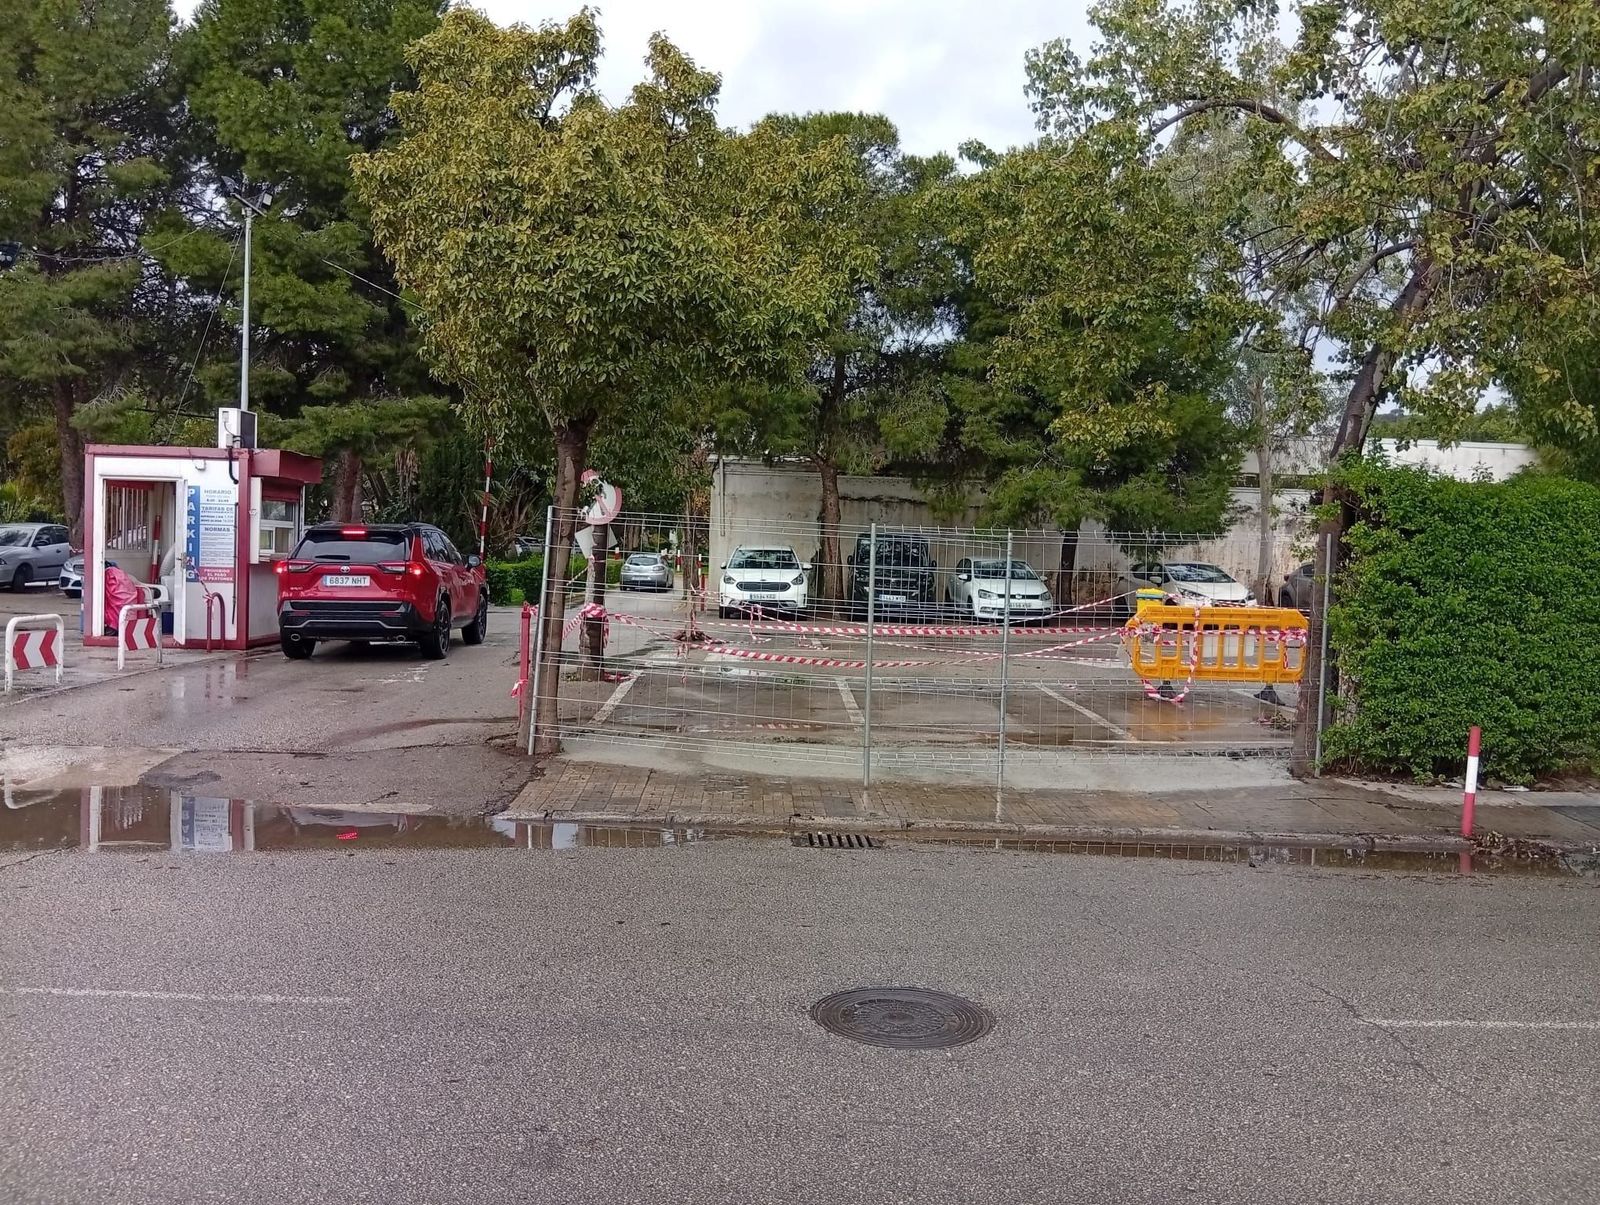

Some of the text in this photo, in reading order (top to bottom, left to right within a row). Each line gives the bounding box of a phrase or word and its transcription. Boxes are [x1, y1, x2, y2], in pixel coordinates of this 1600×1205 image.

[187, 488, 196, 579] PARKING
[329, 576, 367, 585] 6837 NHT
